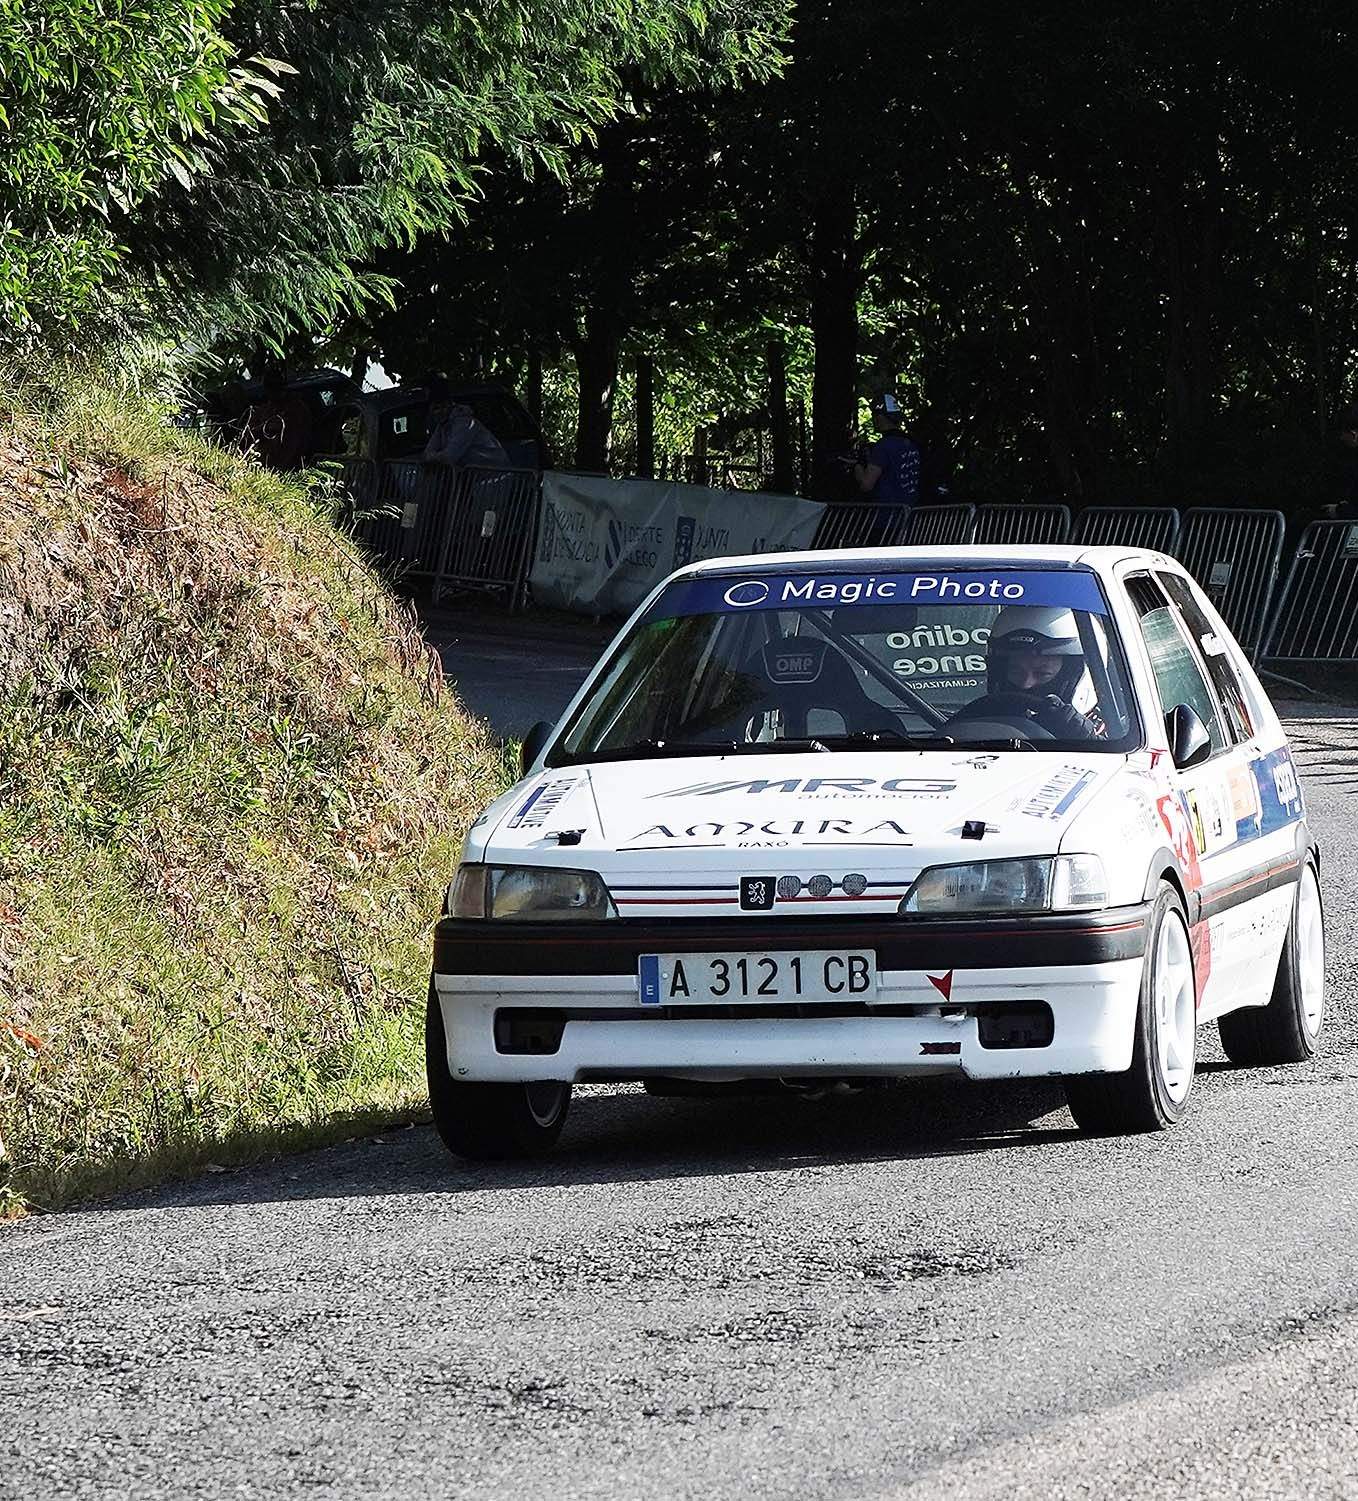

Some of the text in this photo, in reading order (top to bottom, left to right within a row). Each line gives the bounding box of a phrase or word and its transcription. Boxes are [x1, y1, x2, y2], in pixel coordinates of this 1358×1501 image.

[781, 577, 1025, 603] Magic Photo
[776, 658, 813, 672] OMP
[694, 778, 958, 796] MRG
[628, 820, 914, 841] AMURA
[669, 955, 870, 997] A 3121 CB
